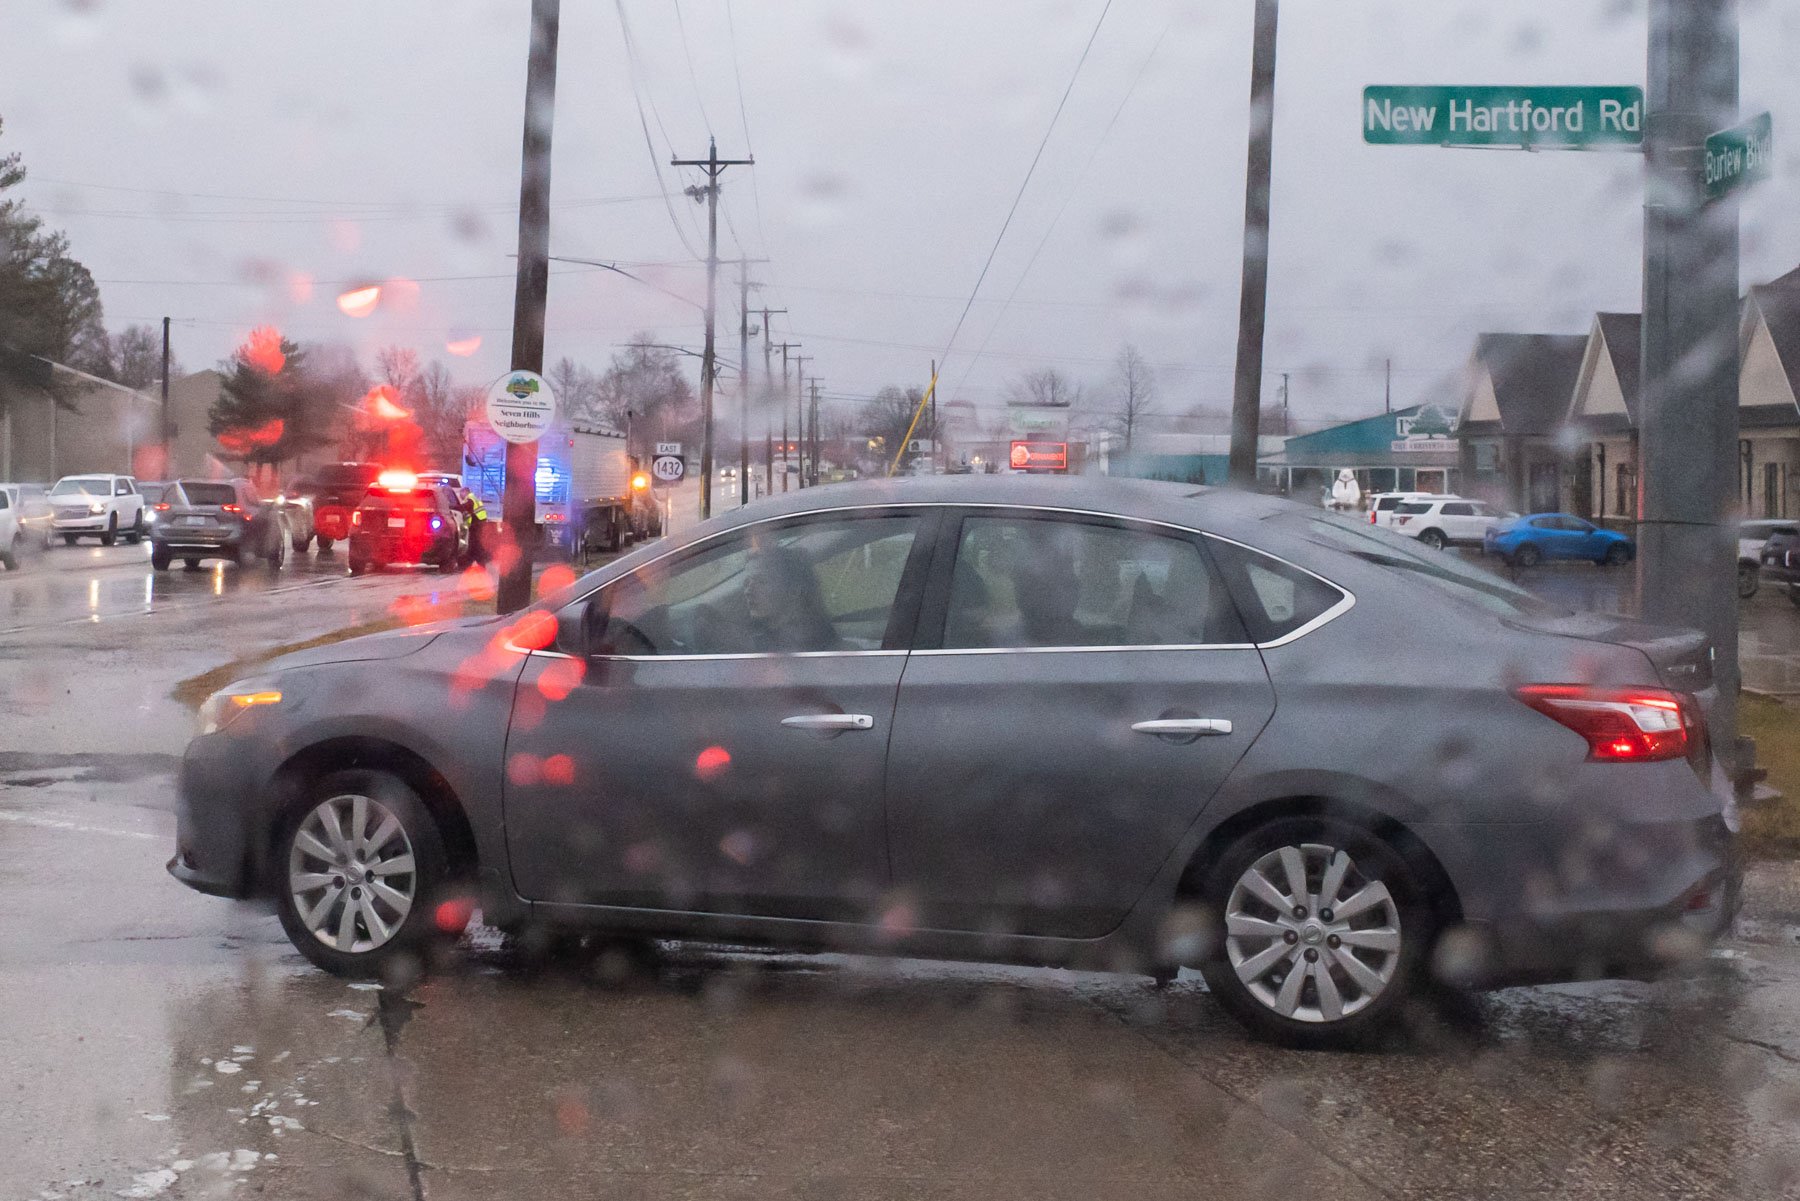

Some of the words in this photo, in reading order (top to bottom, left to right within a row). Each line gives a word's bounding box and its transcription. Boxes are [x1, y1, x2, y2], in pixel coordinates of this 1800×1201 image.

[1367, 98, 1437, 132] New
[1449, 98, 1583, 132] Hartford
[1600, 99, 1641, 132] Rd
[1706, 145, 1741, 185] Burlew
[500, 409, 522, 418] Seven
[522, 410, 541, 419] Hills
[660, 444, 677, 453] EAST
[656, 461, 680, 476] 1432
